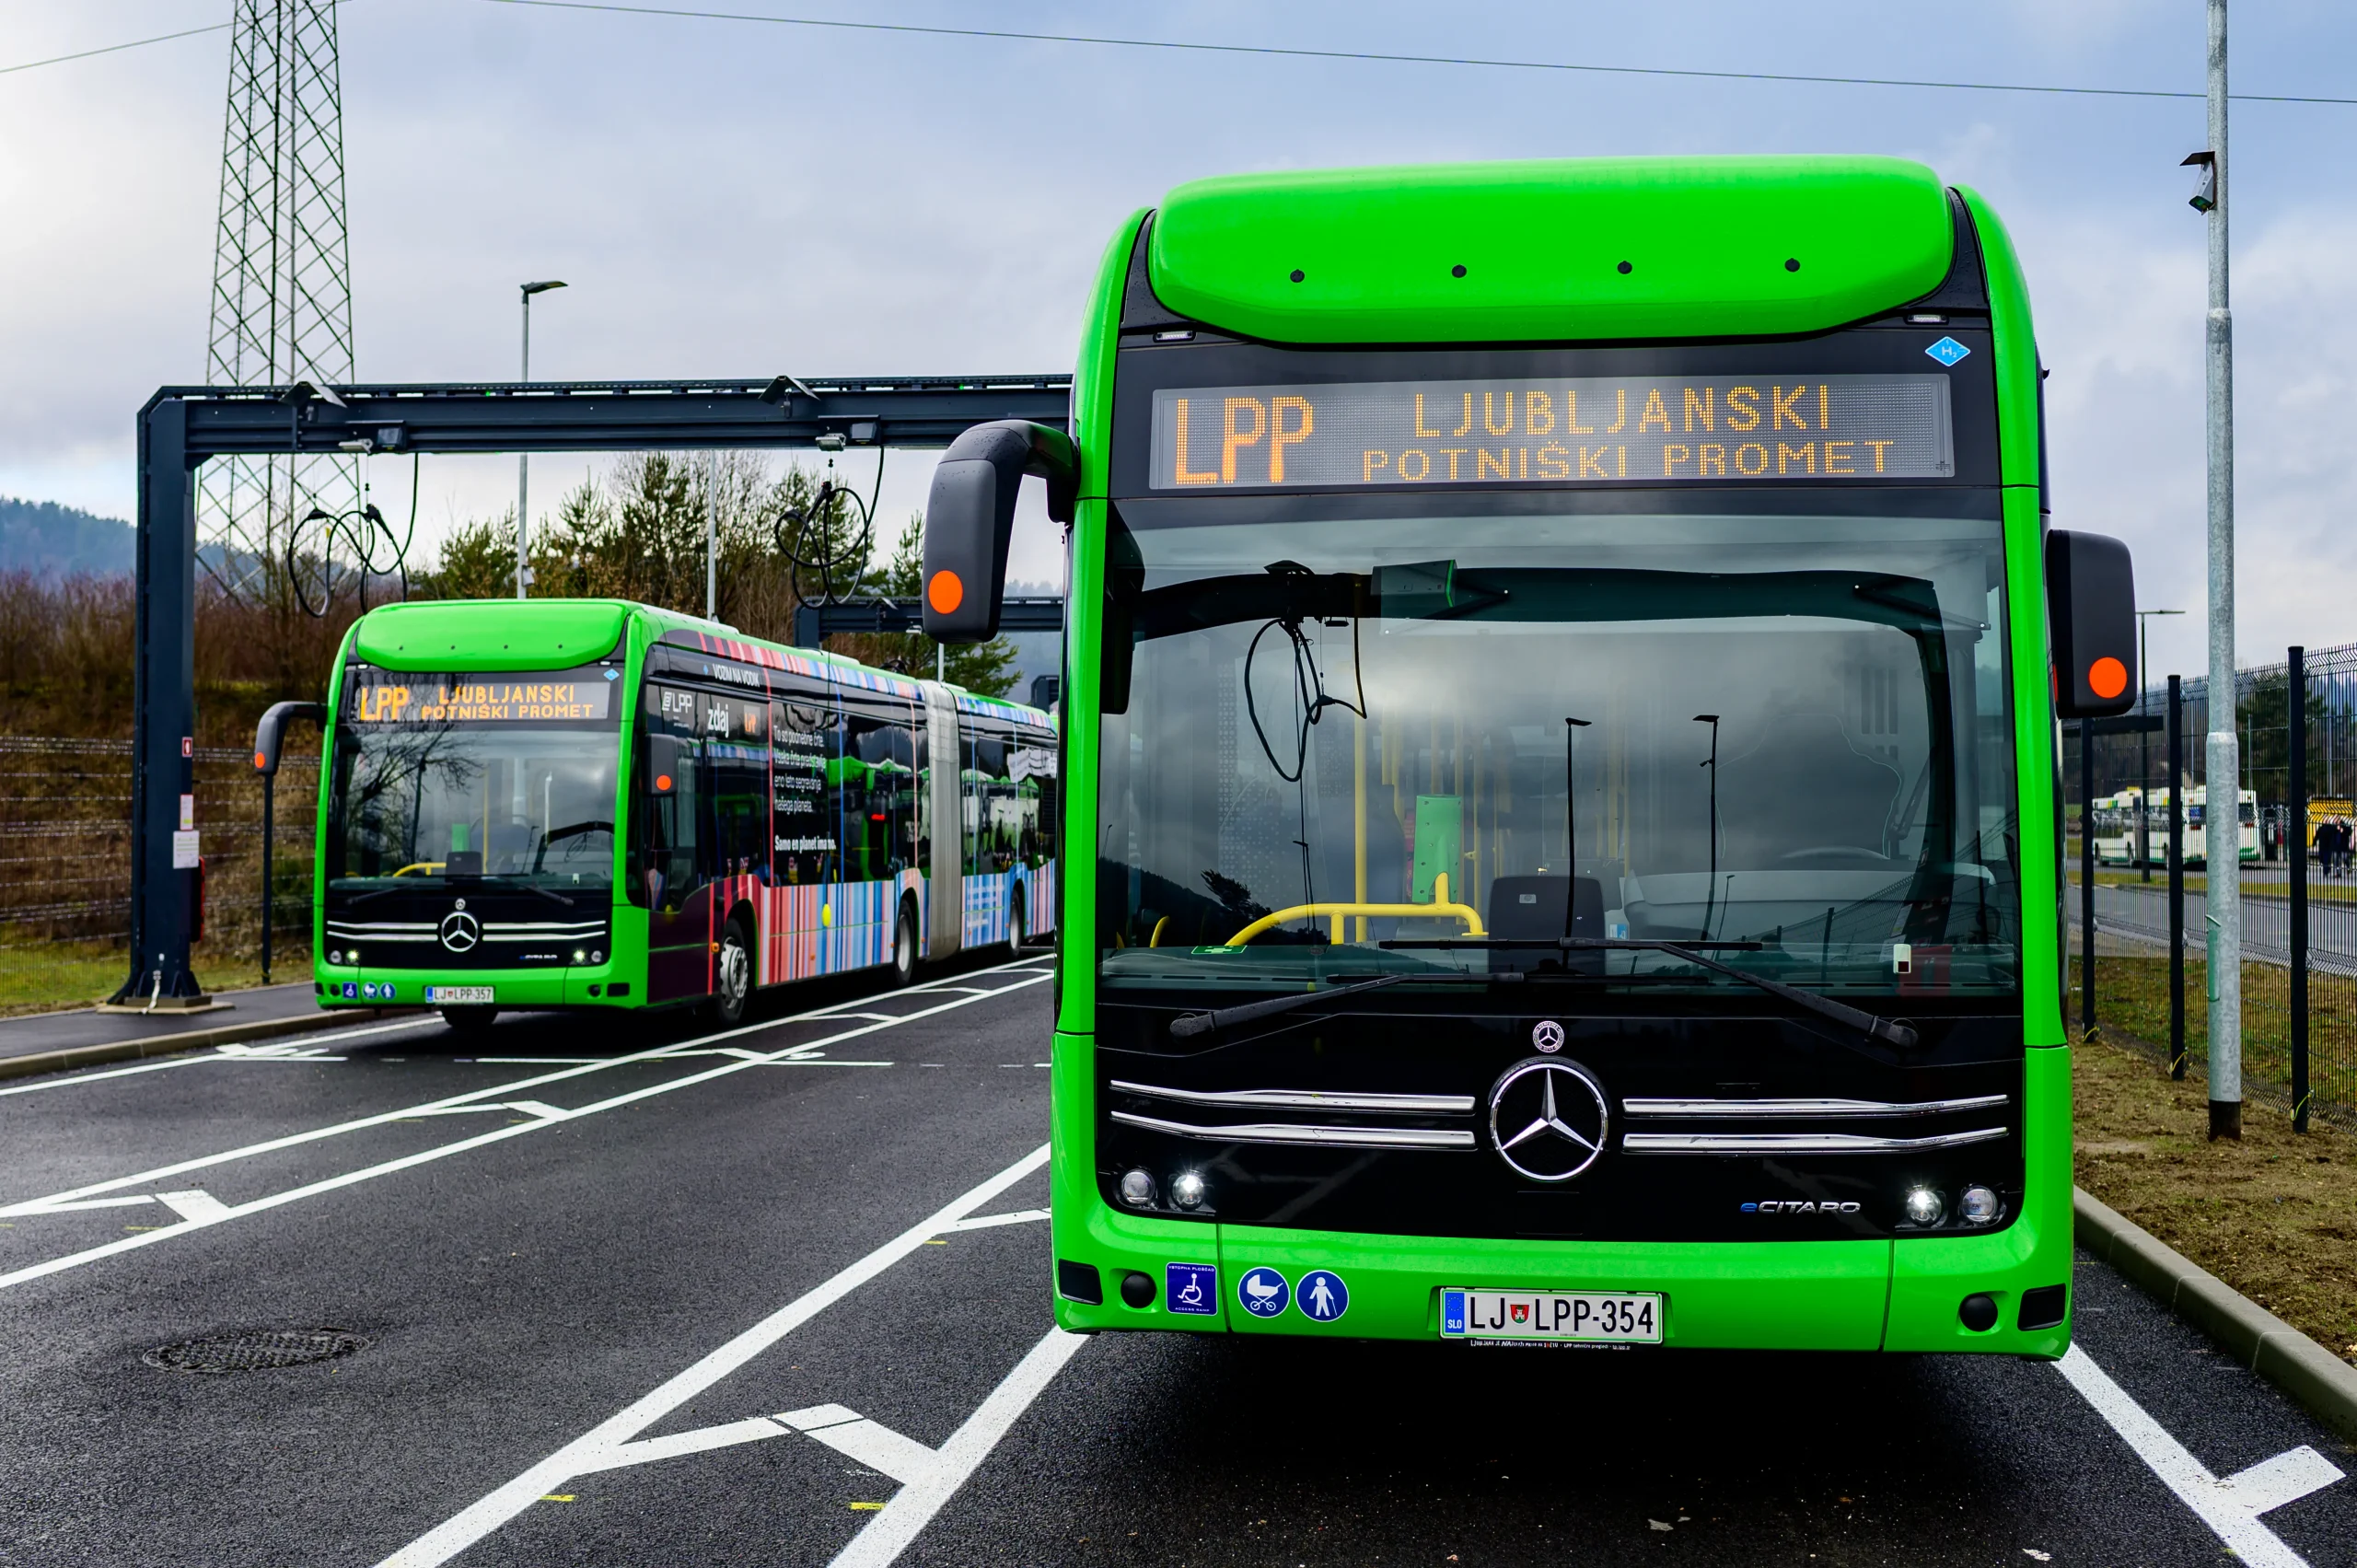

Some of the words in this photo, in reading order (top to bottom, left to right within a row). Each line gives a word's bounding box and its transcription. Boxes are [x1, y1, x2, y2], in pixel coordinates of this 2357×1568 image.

[1416, 385, 1829, 437] LJUBLJANSKI
[1176, 396, 1314, 484] LPP
[1364, 443, 1627, 481] POTNIŠKI
[1664, 440, 1894, 476] PROMET
[359, 686, 410, 721] LPP
[438, 684, 575, 705] LJUBLJANSKI
[672, 692, 692, 714] LPP
[422, 703, 508, 720] POTNIŠKI
[518, 703, 594, 718] PROMET
[707, 702, 729, 738] zdaj
[773, 725, 781, 742] To
[781, 729, 788, 743] so
[774, 775, 785, 788] eno
[784, 772, 795, 789] leto
[774, 796, 794, 816] našega
[794, 796, 814, 816] planeta.
[774, 834, 791, 852] Samo
[792, 839, 799, 852] en
[799, 834, 817, 854] planet
[435, 988, 447, 1000] LJ
[1740, 1201, 1862, 1214] eCITARO
[1447, 1318, 1463, 1330] SLO
[1469, 1296, 1505, 1330] LJ
[1535, 1298, 1654, 1334] LPP-354
